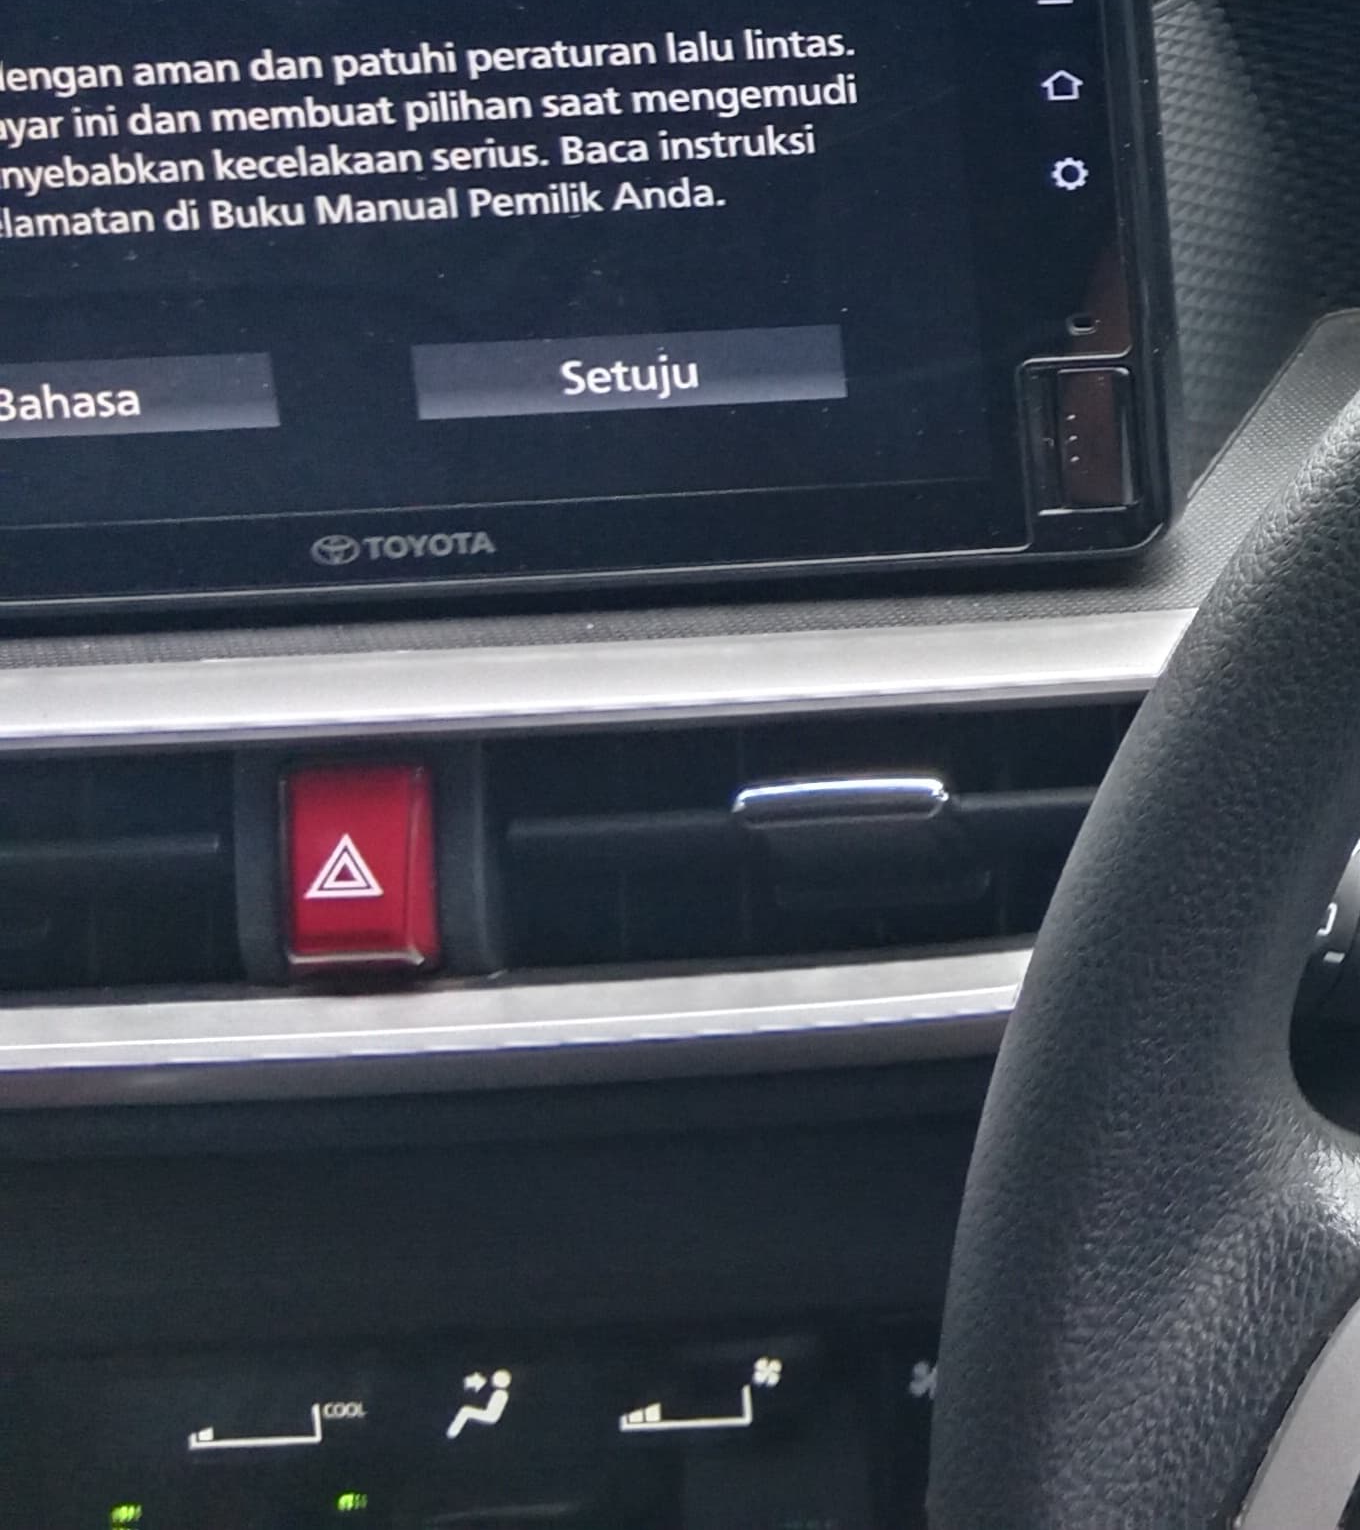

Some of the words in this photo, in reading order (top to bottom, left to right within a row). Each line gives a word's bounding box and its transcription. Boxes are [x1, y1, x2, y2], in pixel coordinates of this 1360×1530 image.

[0, 60, 124, 99] engan
[133, 59, 241, 87] aman
[249, 48, 324, 82] dan
[331, 41, 458, 86] patuhi
[466, 40, 657, 80] peraturan
[665, 30, 735, 64] lalu
[743, 28, 856, 60] lintas.
[71, 104, 119, 138] ini
[127, 102, 202, 136] dan
[210, 95, 397, 132] membuat
[404, 89, 533, 132] pilihan
[541, 87, 623, 118] saat
[631, 73, 858, 119] mengemudi
[211, 143, 424, 181] kecelakaan
[431, 137, 550, 172] serius.
[559, 135, 650, 166] Baca
[658, 123, 816, 161] instruksi
[0, 206, 155, 239] lamatan
[163, 198, 201, 232] di
[209, 195, 306, 230] Buku
[314, 187, 459, 225] Manual
[467, 181, 604, 218] Pemilik
[611, 176, 726, 212] Anda.
[0, 383, 142, 422] Bahasa
[560, 354, 699, 400] Setuju
[363, 531, 497, 561] TOYOTA
[322, 1401, 366, 1420] COOL
